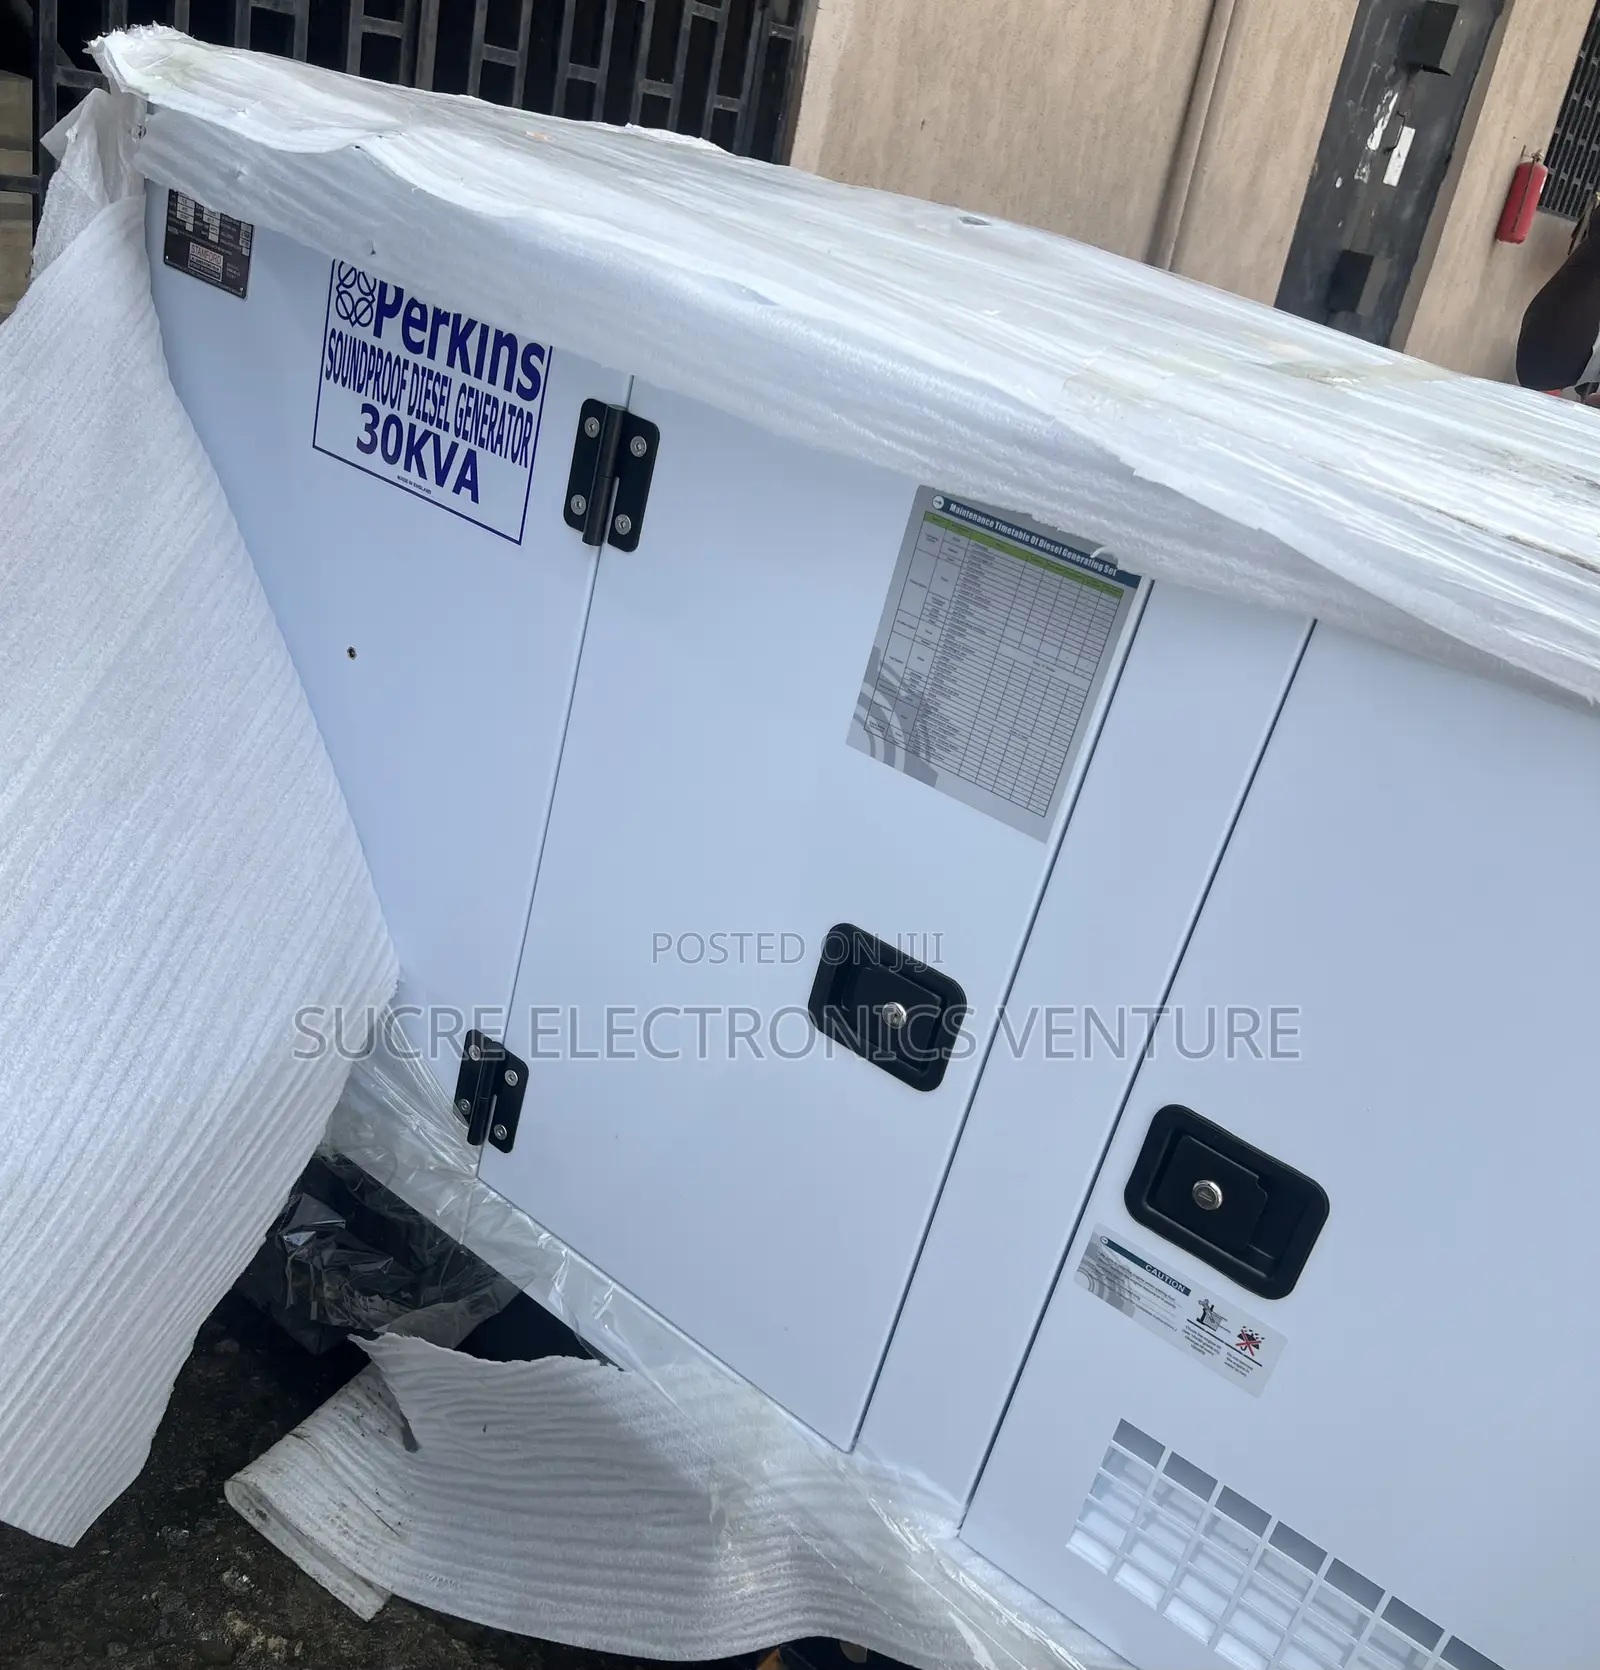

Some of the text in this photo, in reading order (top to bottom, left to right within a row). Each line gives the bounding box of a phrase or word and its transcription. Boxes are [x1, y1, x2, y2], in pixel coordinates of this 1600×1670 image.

[373, 279, 546, 401] Perkins
[325, 327, 534, 468] SOUNDPROOF DIESEL GENERATOR
[356, 403, 479, 504] 30KVA
[949, 502, 995, 529] Maintenance
[994, 519, 1030, 543] Timetable
[1038, 537, 1062, 556] Diesel
[1062, 545, 1104, 573] Generating
[1103, 563, 1118, 578] Set
[1145, 1263, 1186, 1294] CAUTION
